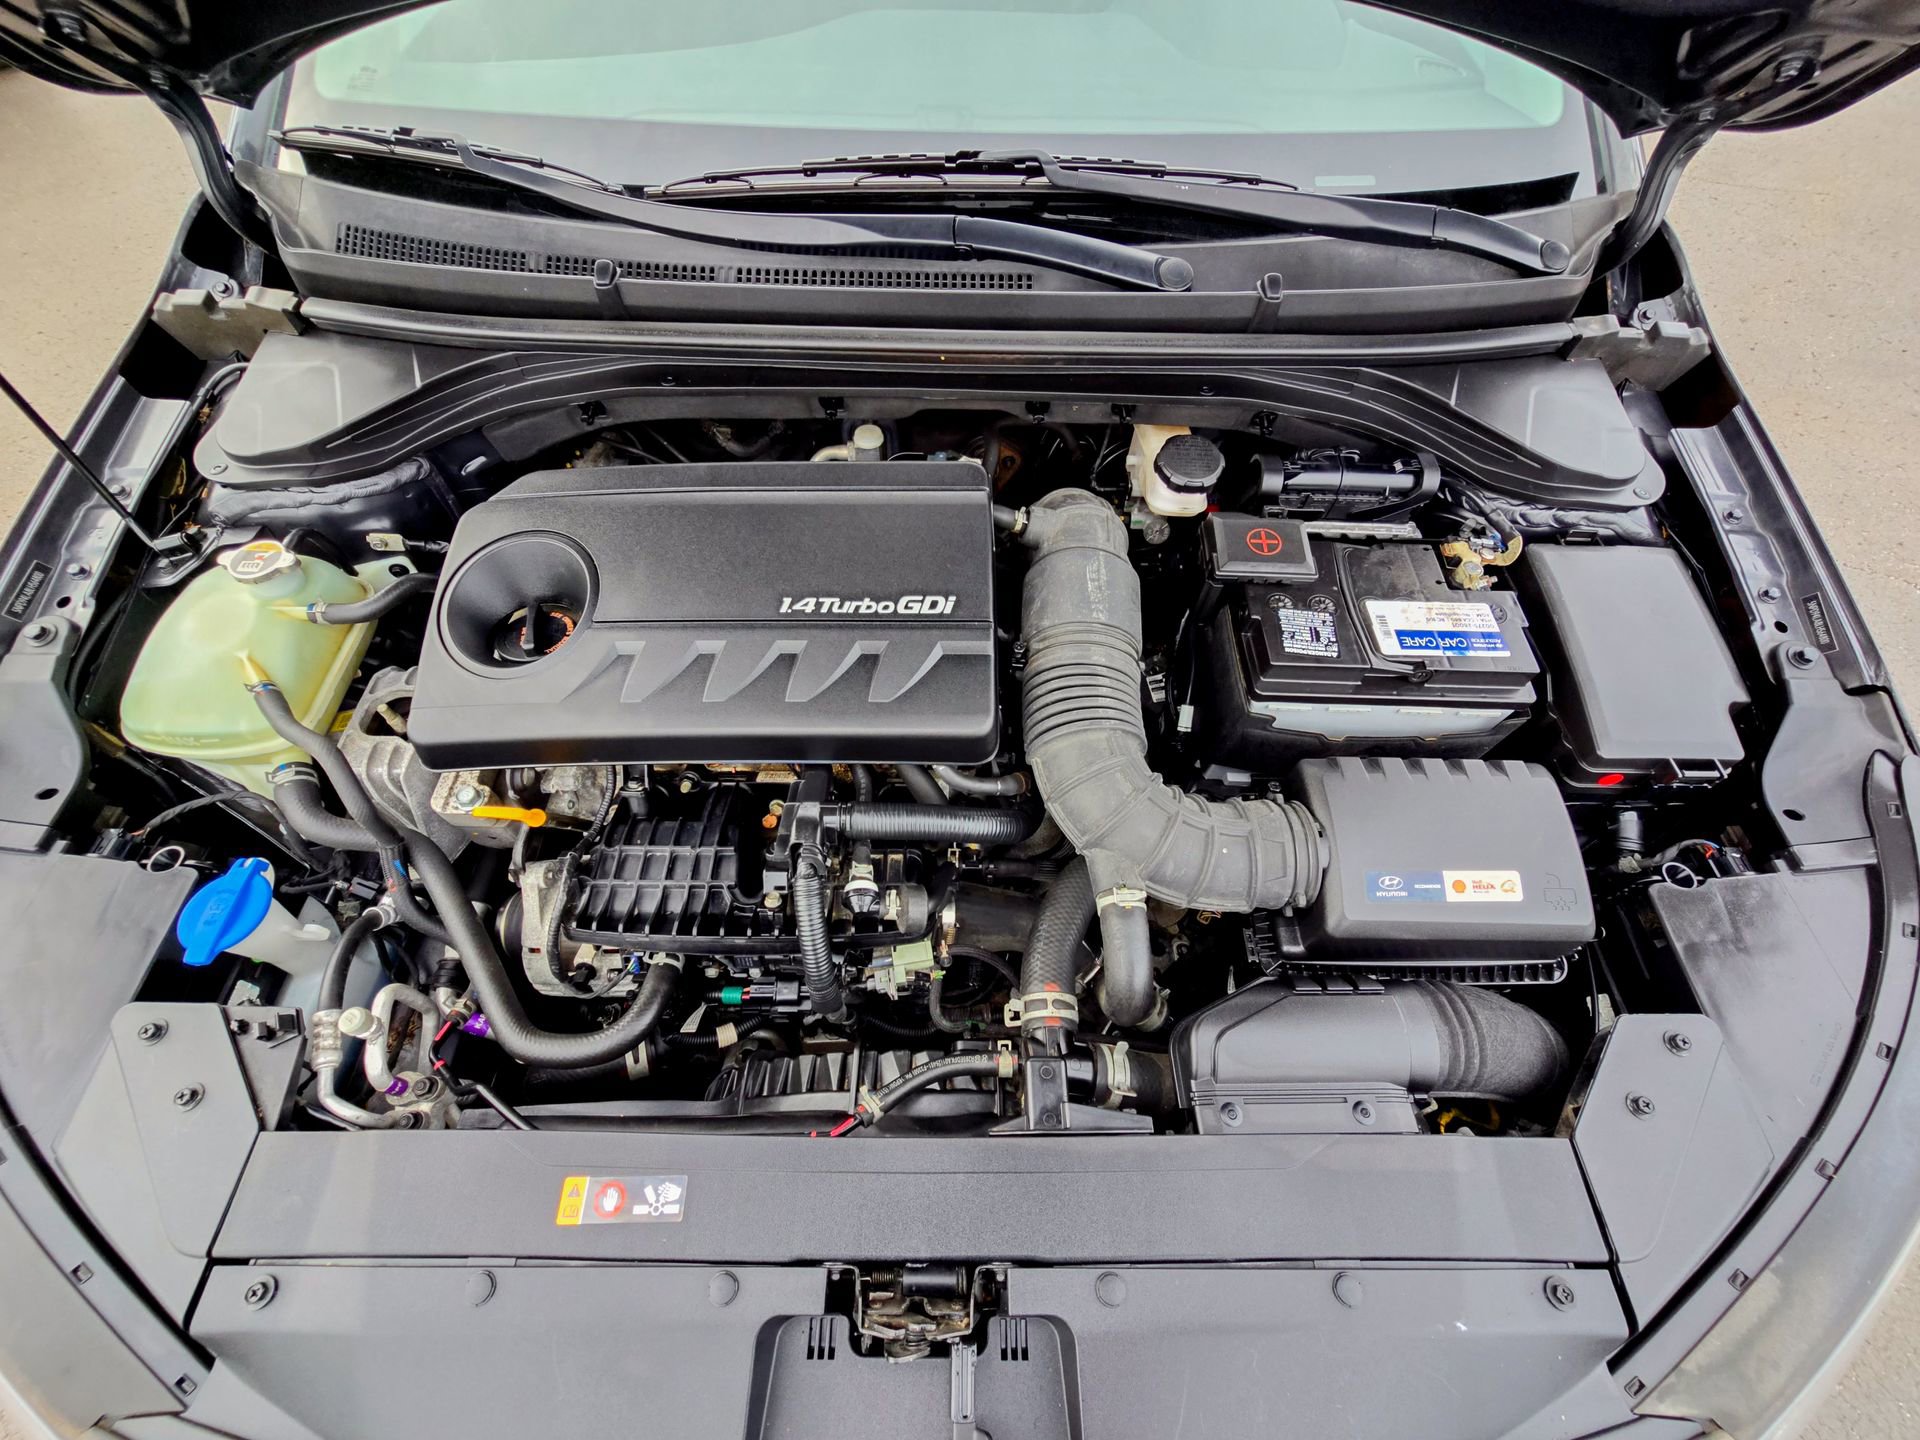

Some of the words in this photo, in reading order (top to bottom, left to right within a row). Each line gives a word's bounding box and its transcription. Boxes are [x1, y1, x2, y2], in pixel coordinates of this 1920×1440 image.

[818, 597, 896, 614] Turbo
[896, 595, 957, 614] GDi
[1400, 636, 1437, 647] CARE
[1439, 637, 1467, 648] CAR
[1472, 882, 1497, 890] HELIX
